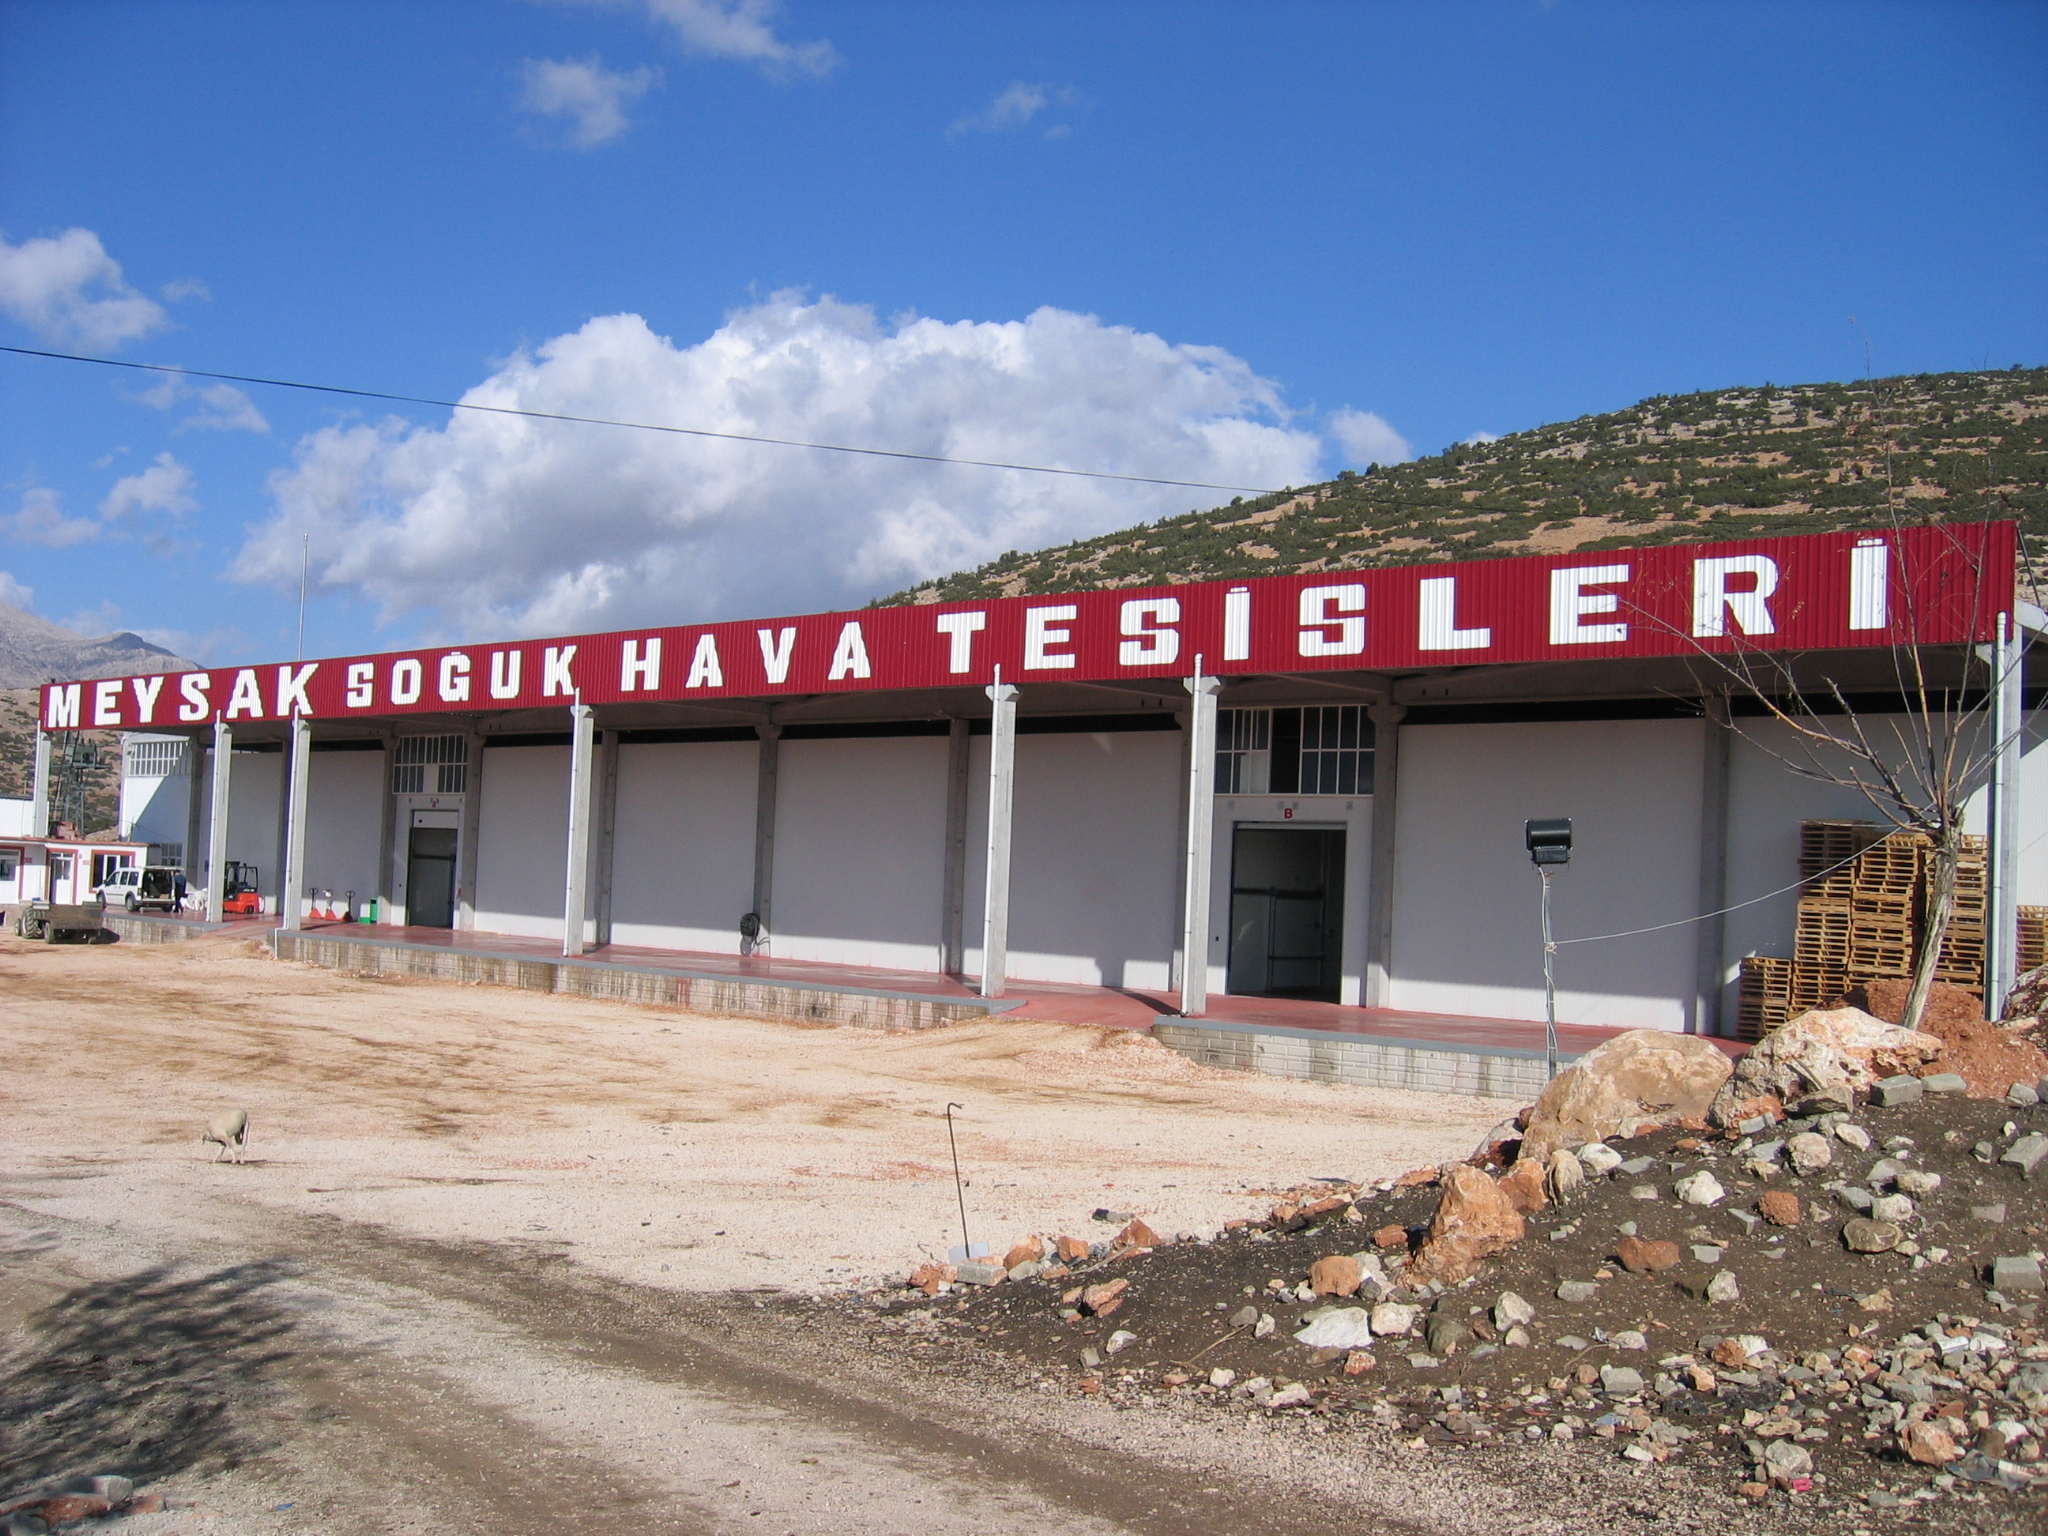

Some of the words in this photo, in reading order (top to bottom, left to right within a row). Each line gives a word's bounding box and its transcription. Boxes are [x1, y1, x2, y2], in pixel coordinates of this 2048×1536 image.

[47, 662, 319, 728] MEYSAK
[621, 621, 871, 692] HAVA
[1284, 808, 1293, 818] B
